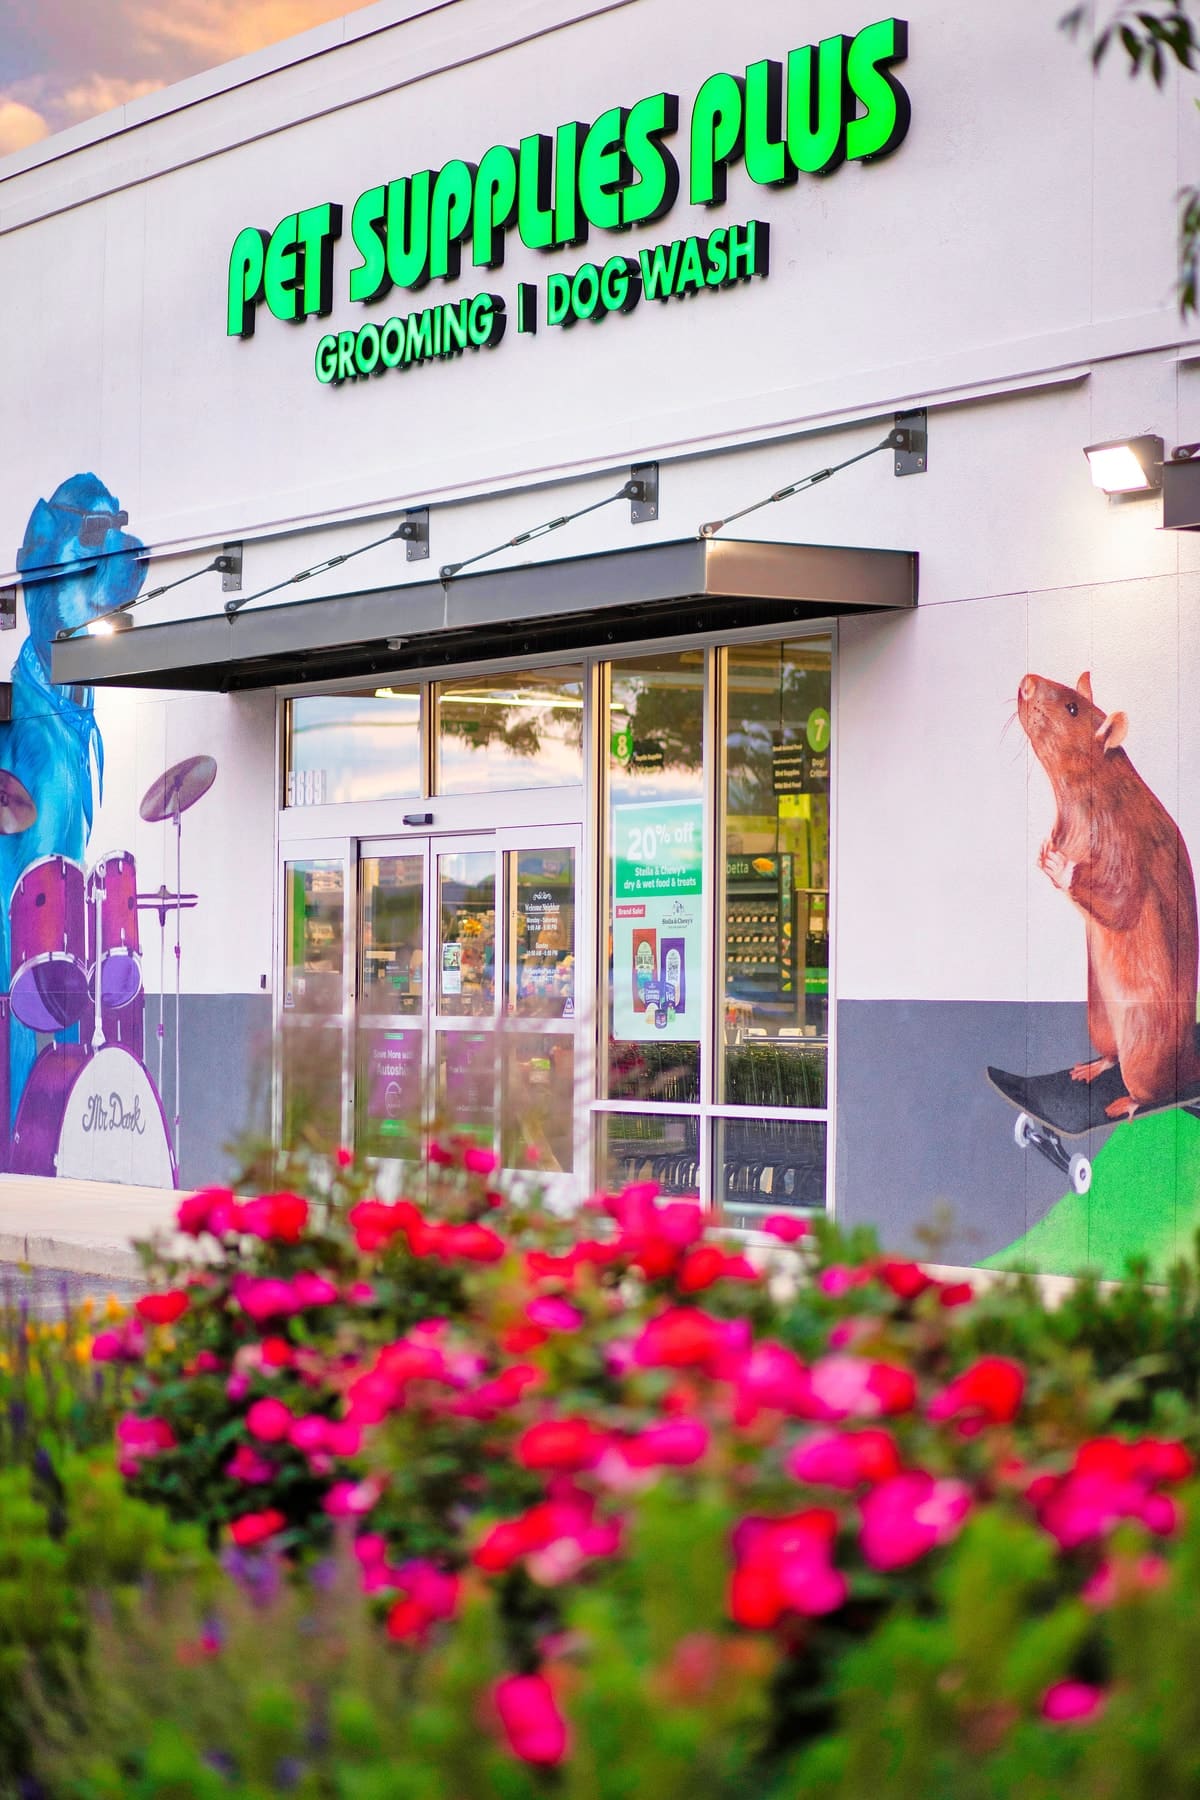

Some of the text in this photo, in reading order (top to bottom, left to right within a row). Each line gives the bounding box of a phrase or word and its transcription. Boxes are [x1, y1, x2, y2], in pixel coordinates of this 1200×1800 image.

[227, 17, 904, 336] PET SUPPLIES PLUS
[315, 293, 500, 384] GROOMING
[547, 255, 634, 326] DOG
[639, 220, 761, 300] WASH
[814, 718, 825, 741] 7
[617, 735, 628, 757] 8
[627, 822, 694, 861] 20% off
[624, 880, 635, 891] dry
[636, 880, 642, 889] &
[643, 879, 655, 888] wet
[656, 878, 670, 888] food
[677, 877, 696, 886] treats
[635, 866, 653, 876] Stella
[82, 1093, 108, 1132] Mr
